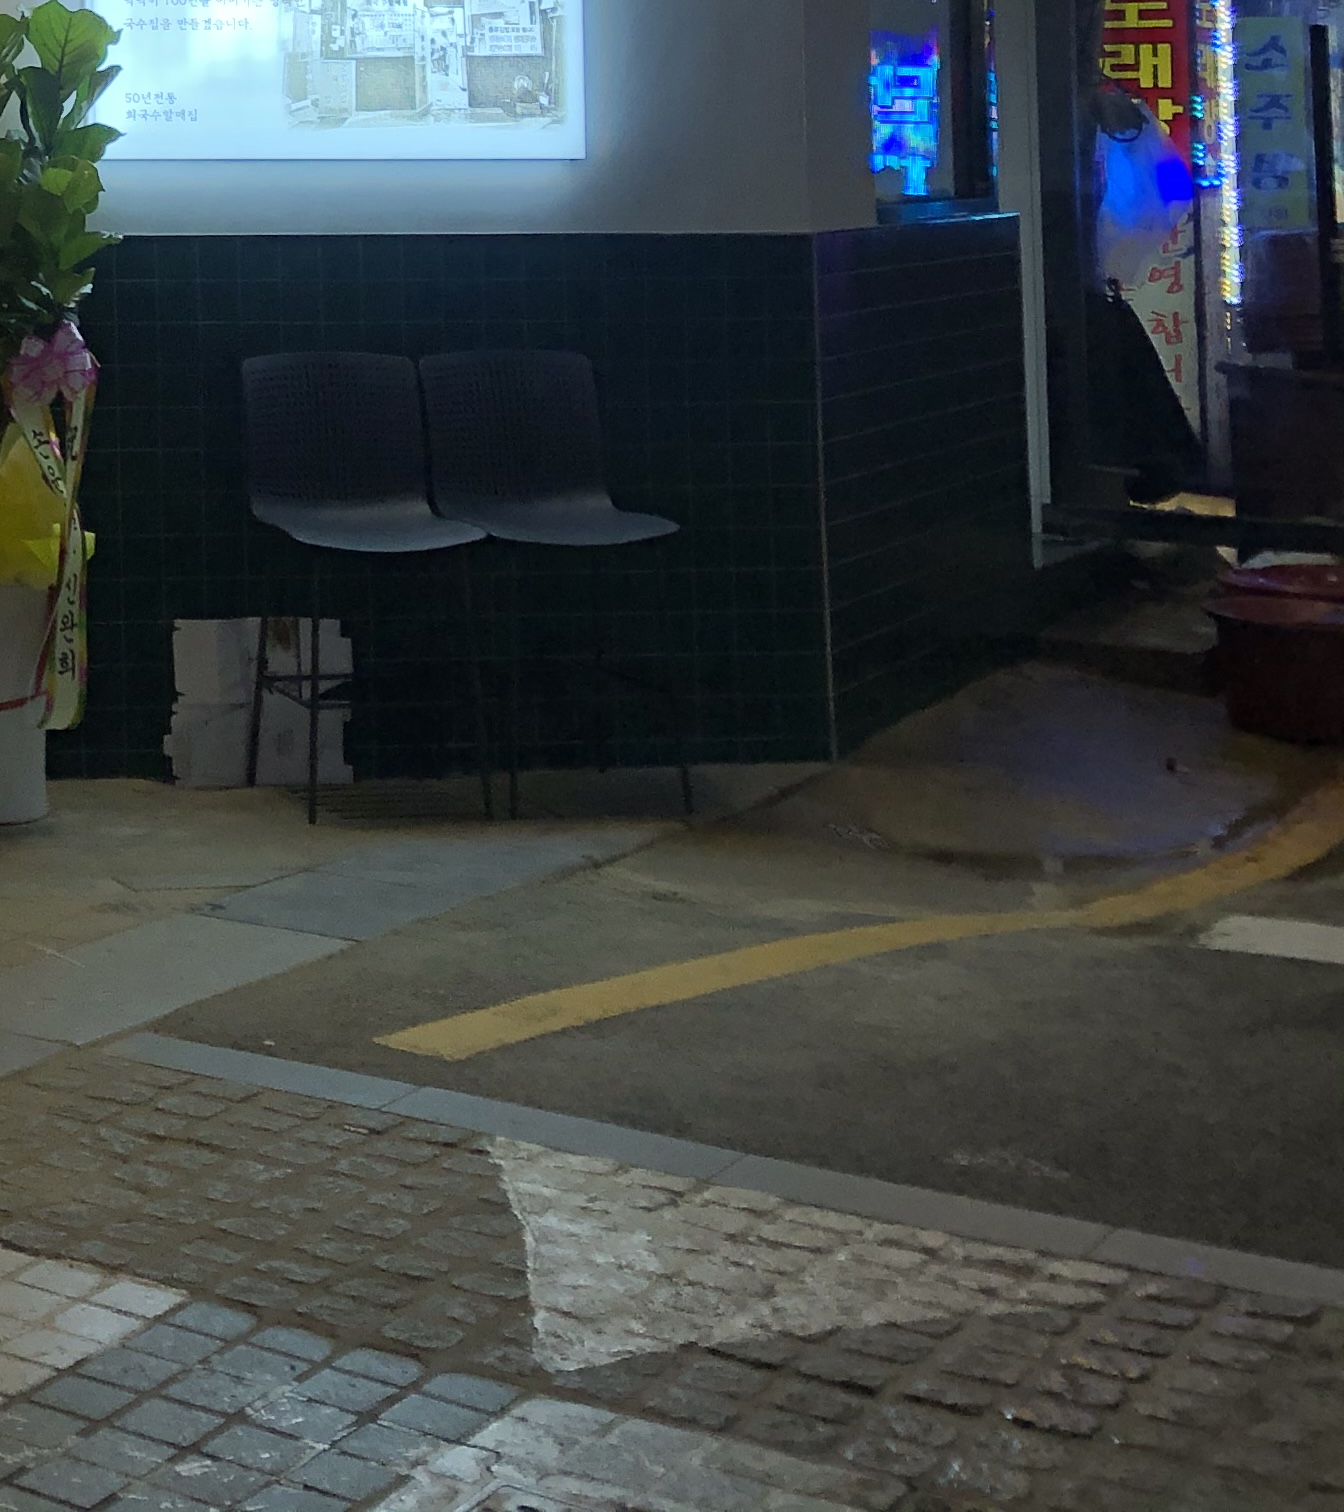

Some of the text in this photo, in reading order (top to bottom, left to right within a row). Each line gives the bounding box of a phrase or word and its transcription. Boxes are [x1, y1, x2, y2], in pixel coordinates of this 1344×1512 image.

[123, 17, 253, 31] 국수집을 만들겠습니다.
[125, 91, 177, 105] 50년전통
[126, 108, 198, 122] 회국수할매집
[1242, 34, 1306, 191] 소주방
